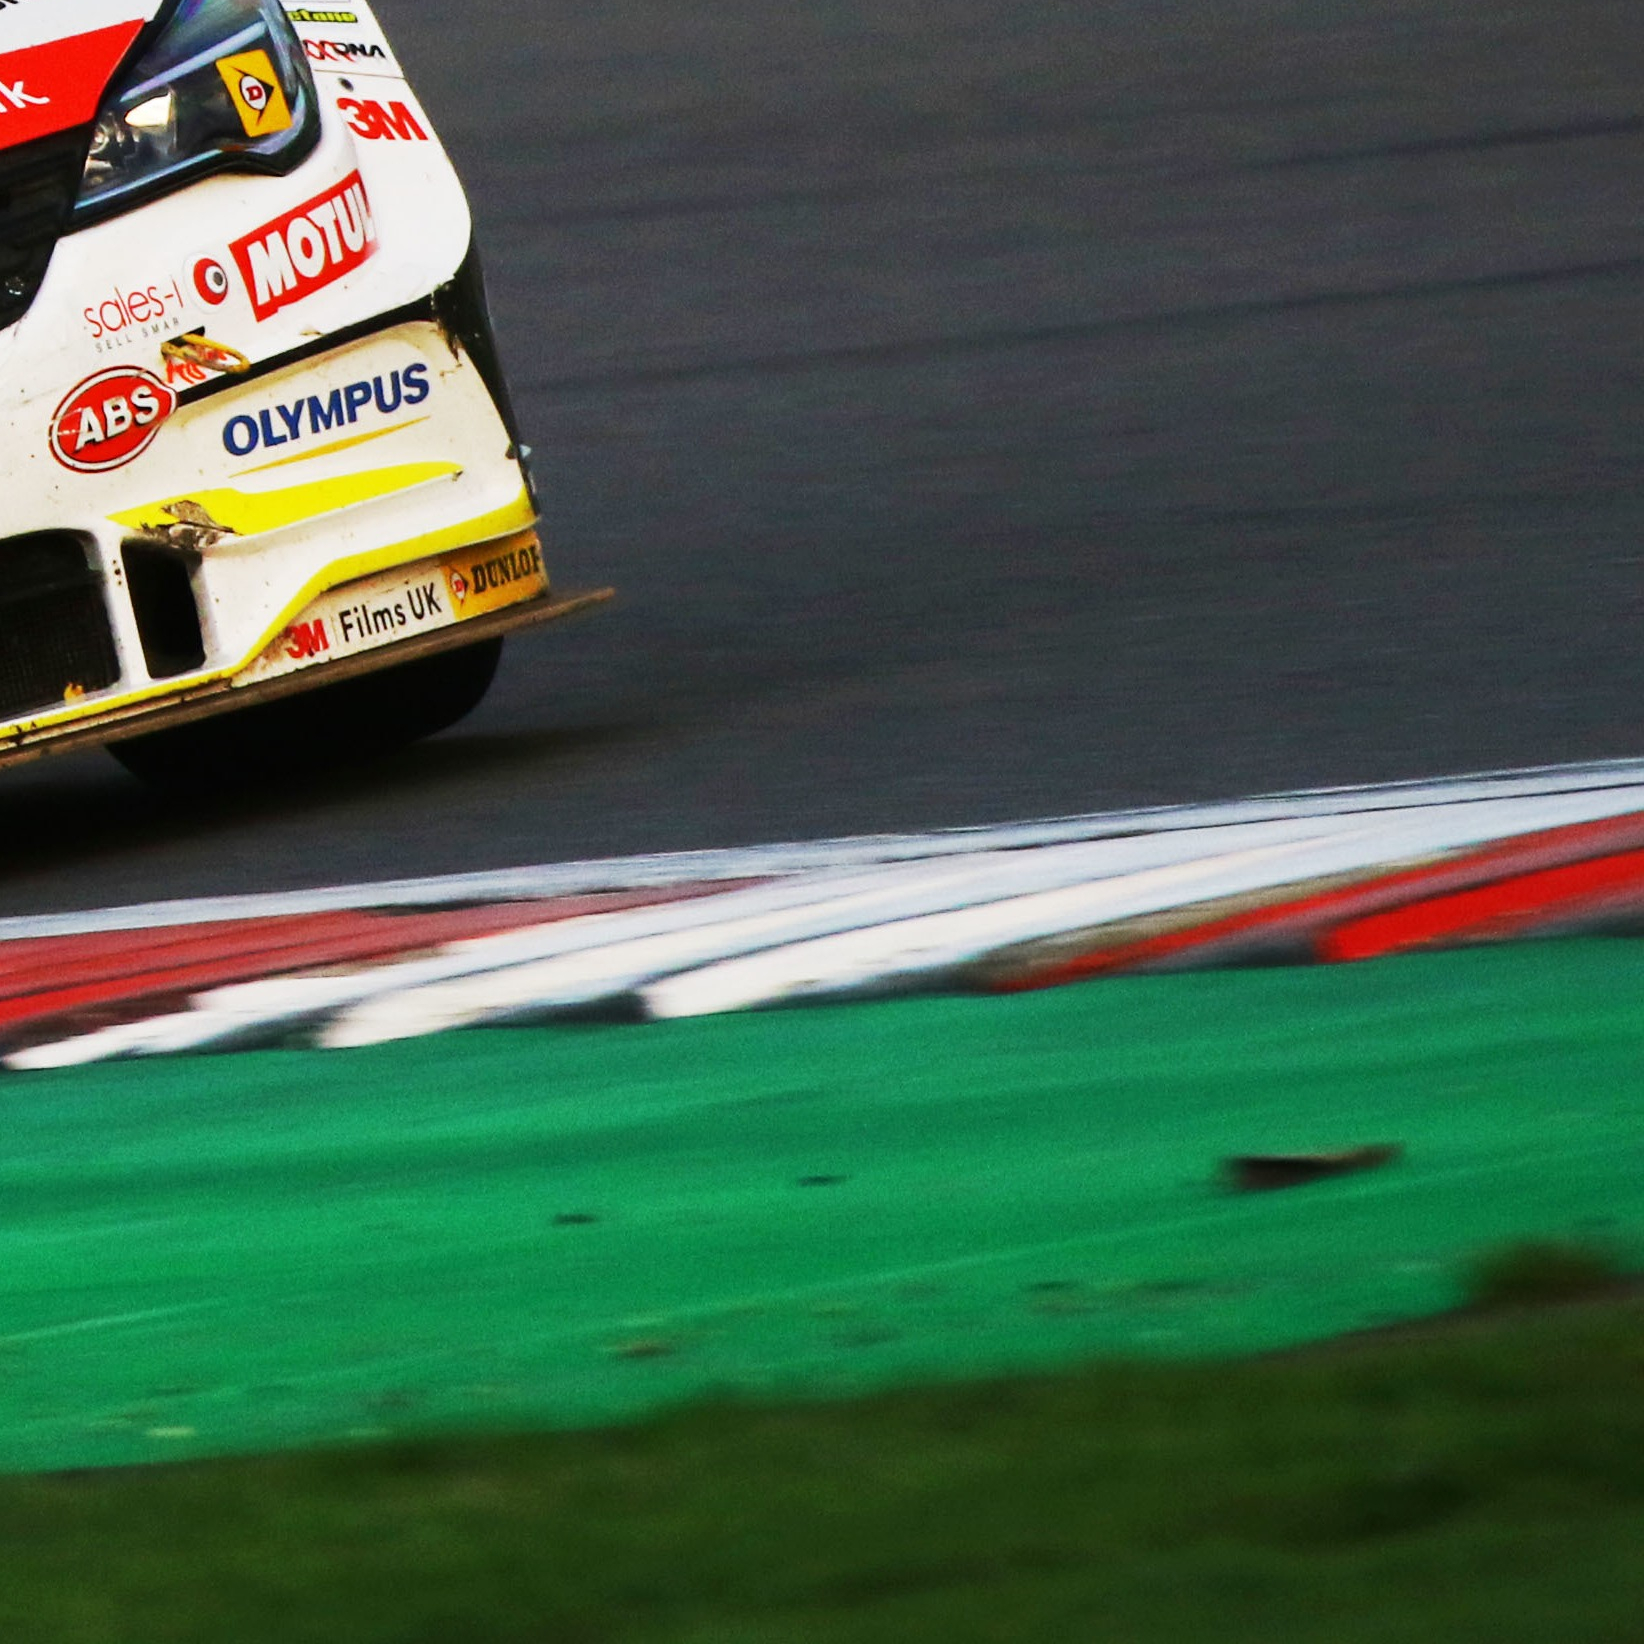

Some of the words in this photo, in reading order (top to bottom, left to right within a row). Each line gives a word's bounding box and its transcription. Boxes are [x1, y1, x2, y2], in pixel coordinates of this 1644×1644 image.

[288, 9, 358, 23] ctane
[336, 97, 429, 141] 3M
[245, 182, 376, 306] MOTUL
[94, 334, 133, 354] SELL
[72, 382, 161, 452] ABS
[221, 362, 431, 457] OLYMPUS
[285, 617, 329, 660] 3M
[340, 596, 406, 644] Films
[406, 582, 444, 621] UK
